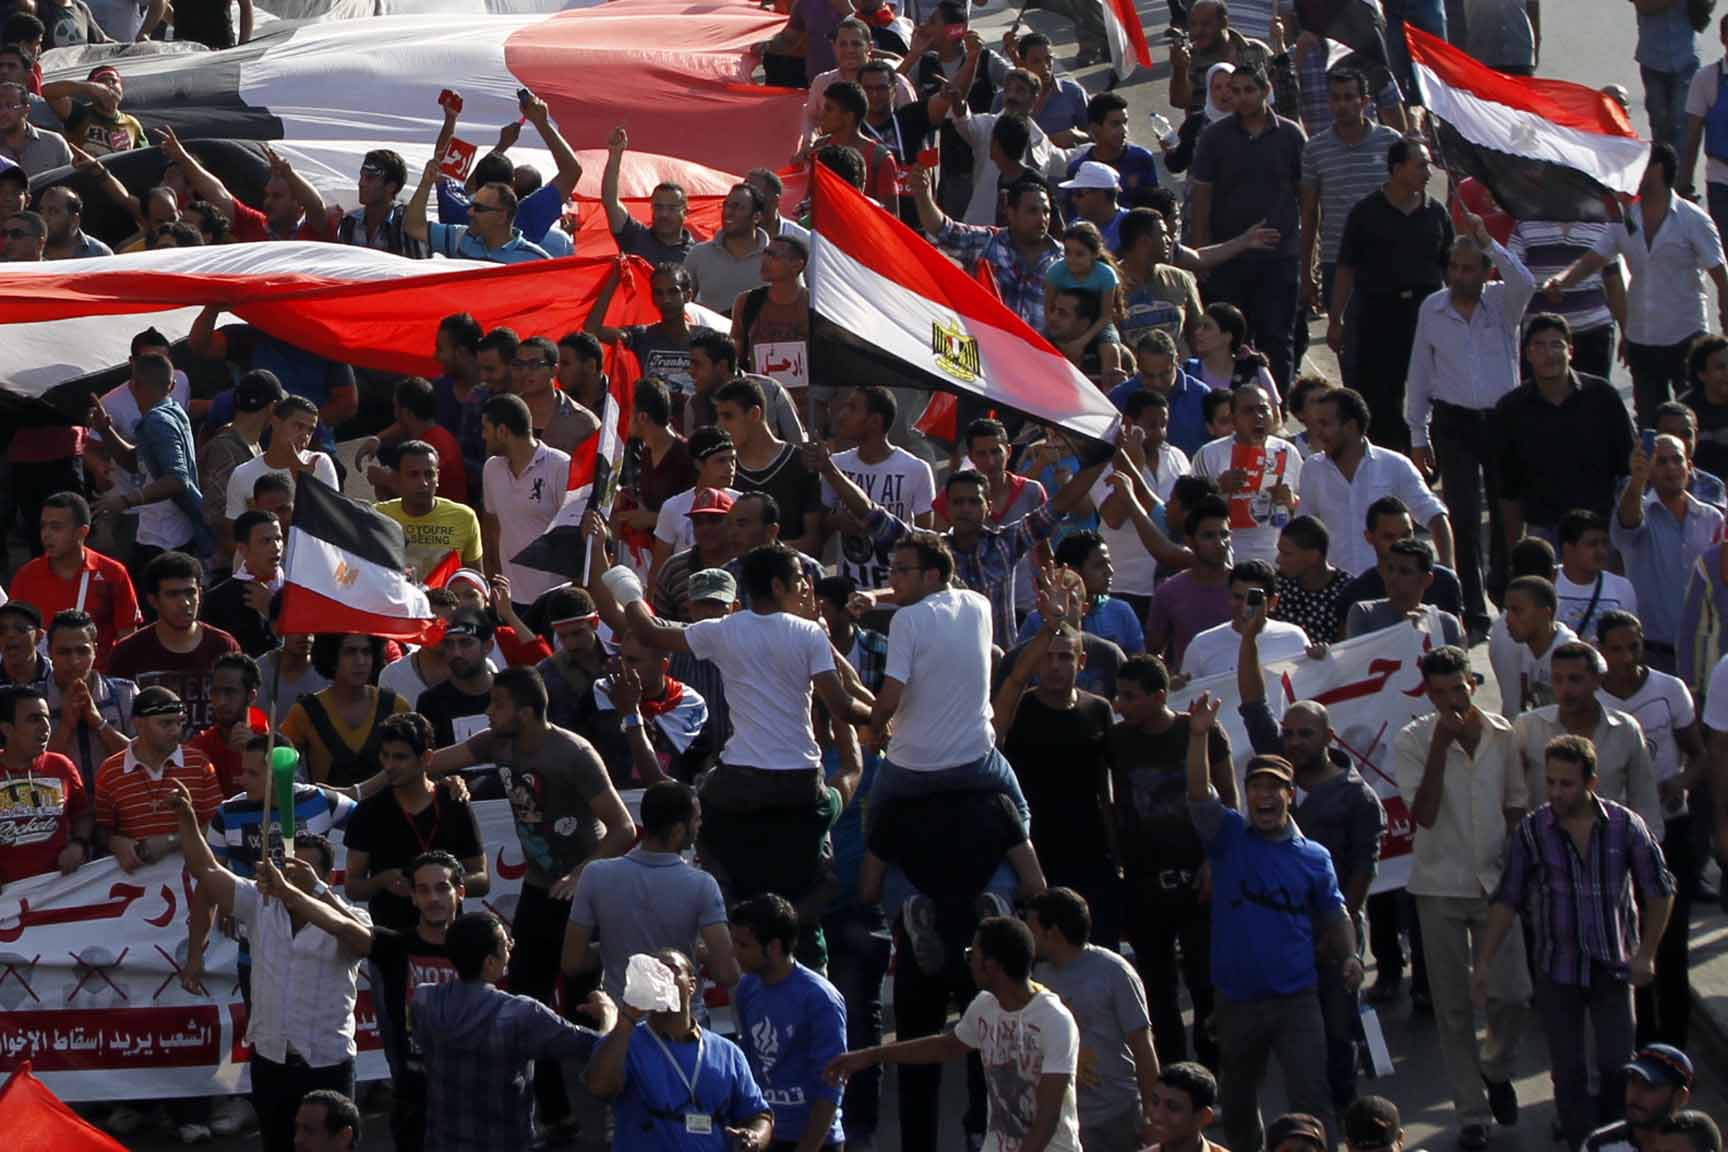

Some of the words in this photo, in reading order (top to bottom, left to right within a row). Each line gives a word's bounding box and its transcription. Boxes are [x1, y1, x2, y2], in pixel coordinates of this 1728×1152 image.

[881, 474, 904, 503] AT
[52, 1027, 103, 1056] إسقاط
[109, 1030, 153, 1056] يريد
[159, 1019, 211, 1051] الشعب
